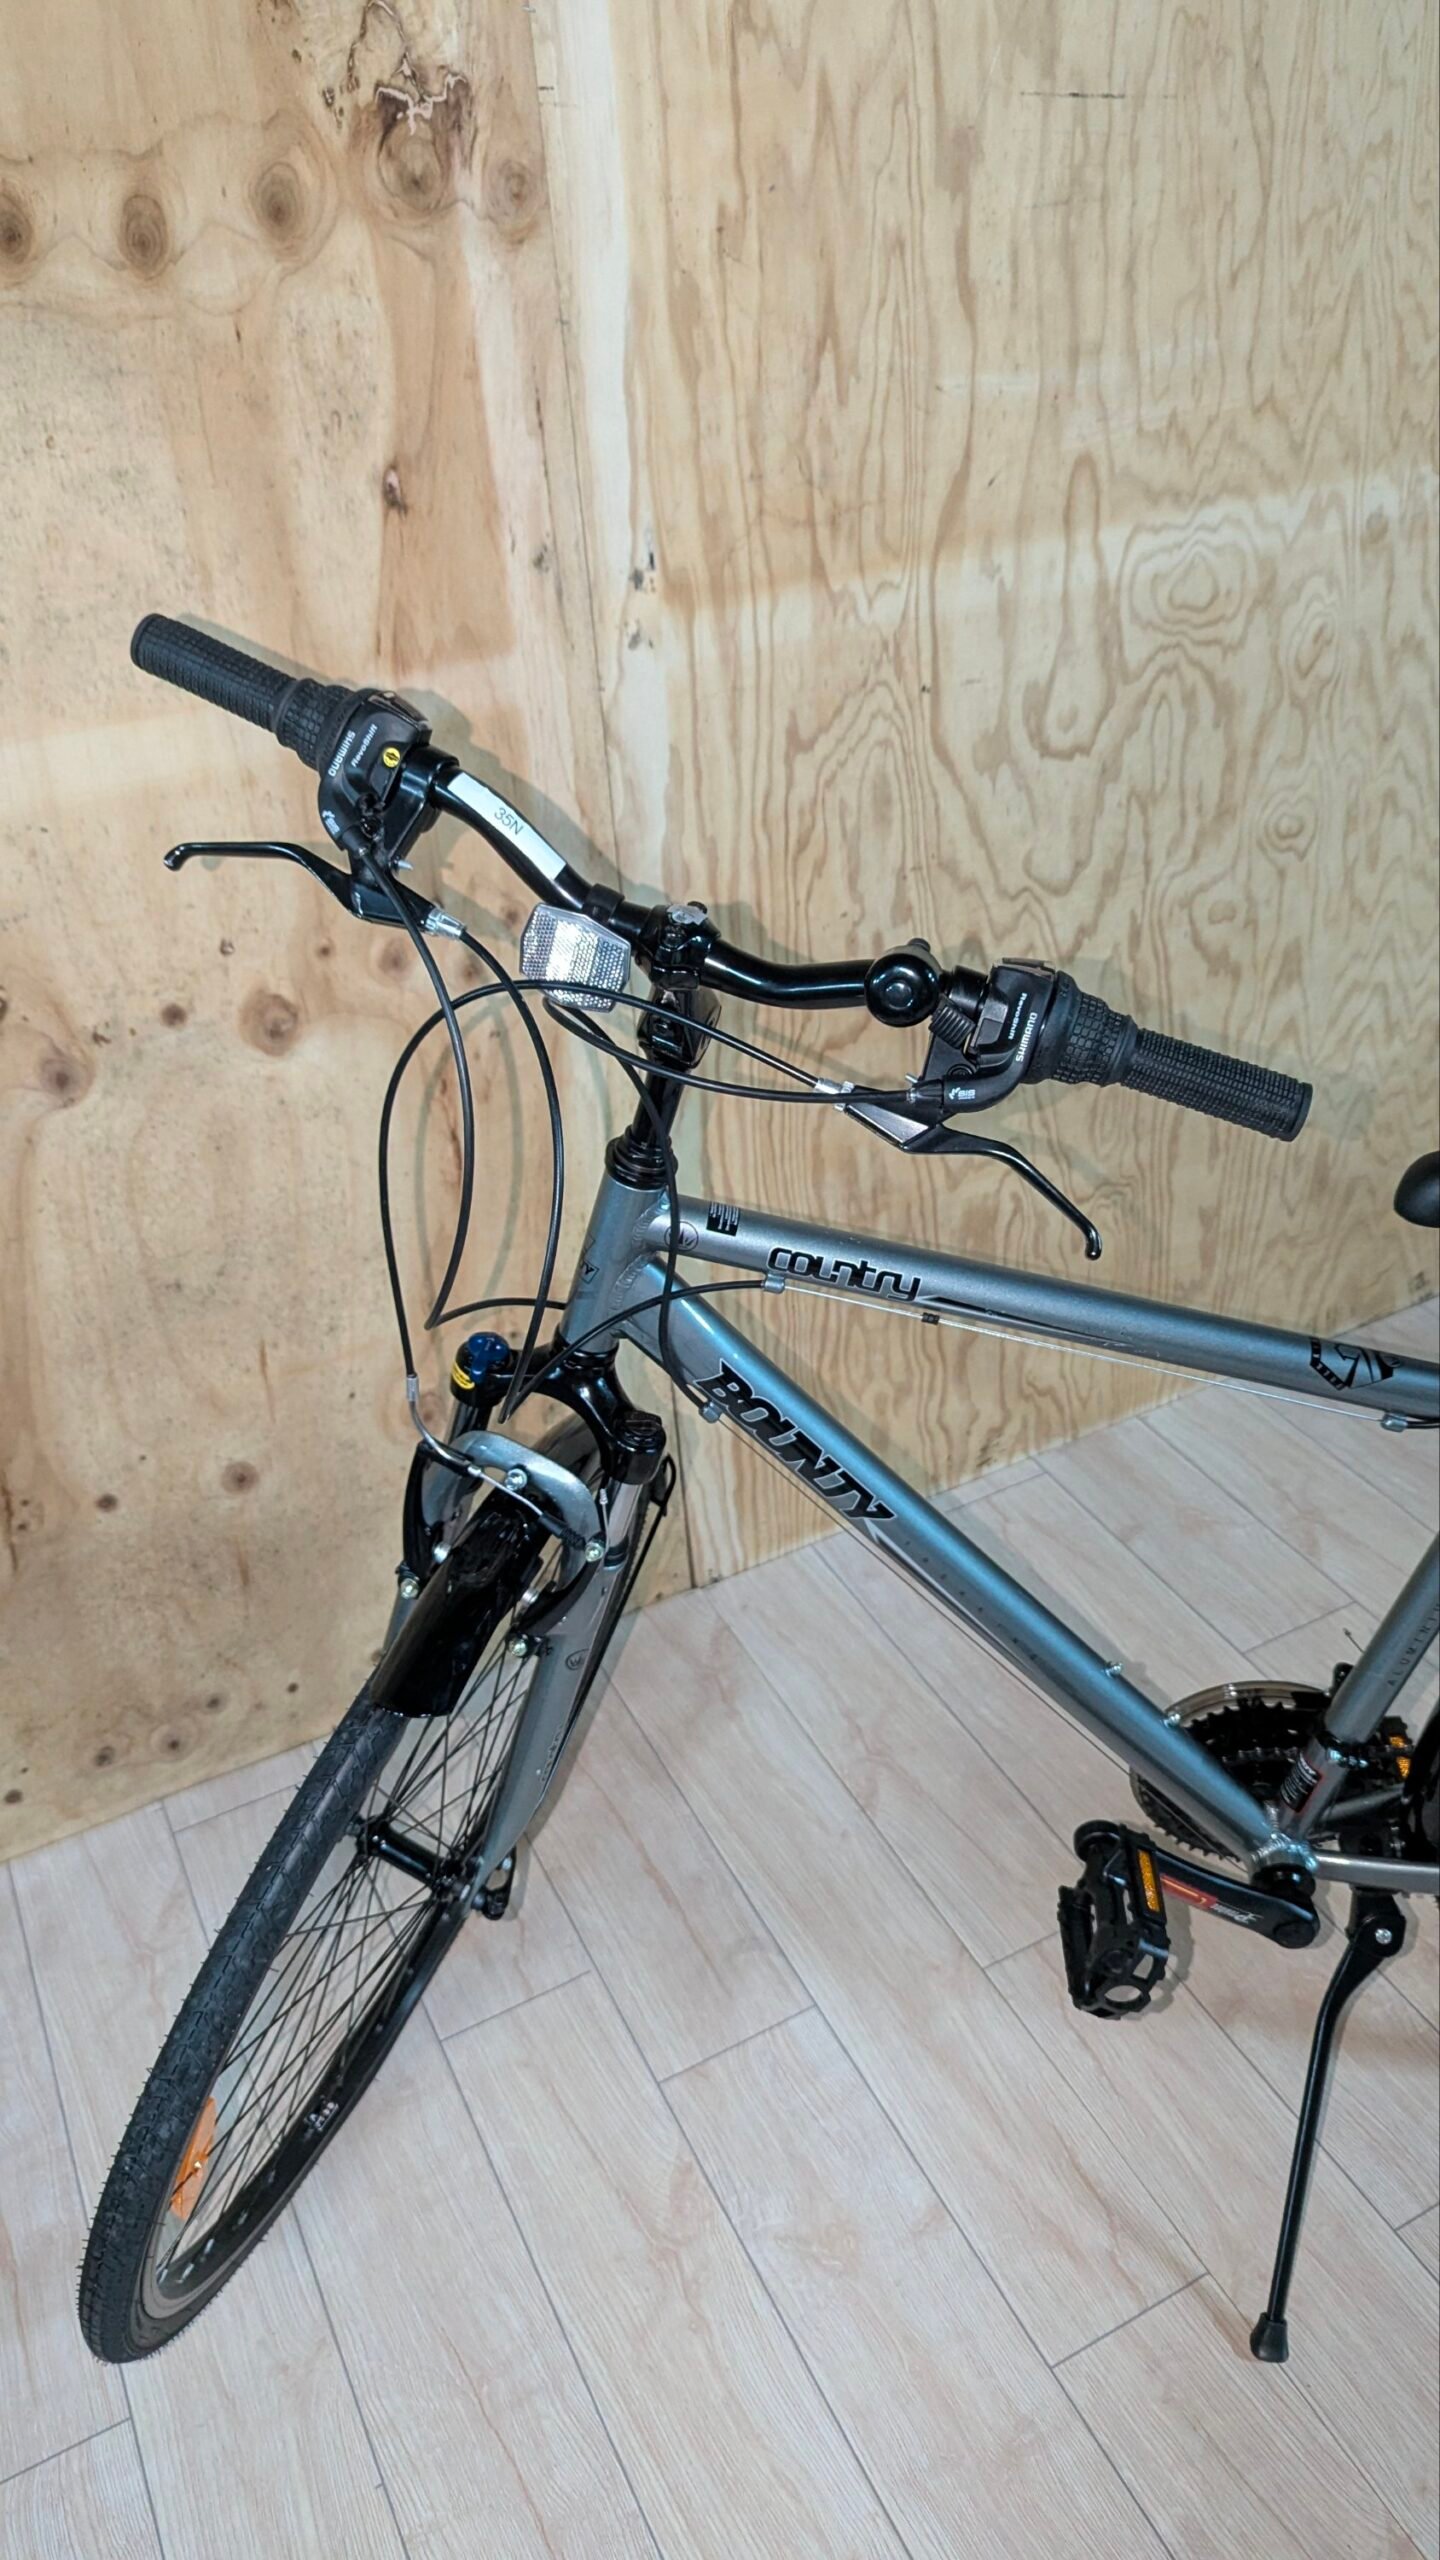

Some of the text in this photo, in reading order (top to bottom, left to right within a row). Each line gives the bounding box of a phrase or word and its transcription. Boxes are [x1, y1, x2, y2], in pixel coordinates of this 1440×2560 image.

[328, 730, 356, 777] SHIMANO
[494, 807, 524, 836] 35N
[1016, 1012, 1038, 1062] SHIMANO
[694, 1358, 897, 1519] BOUNTY
